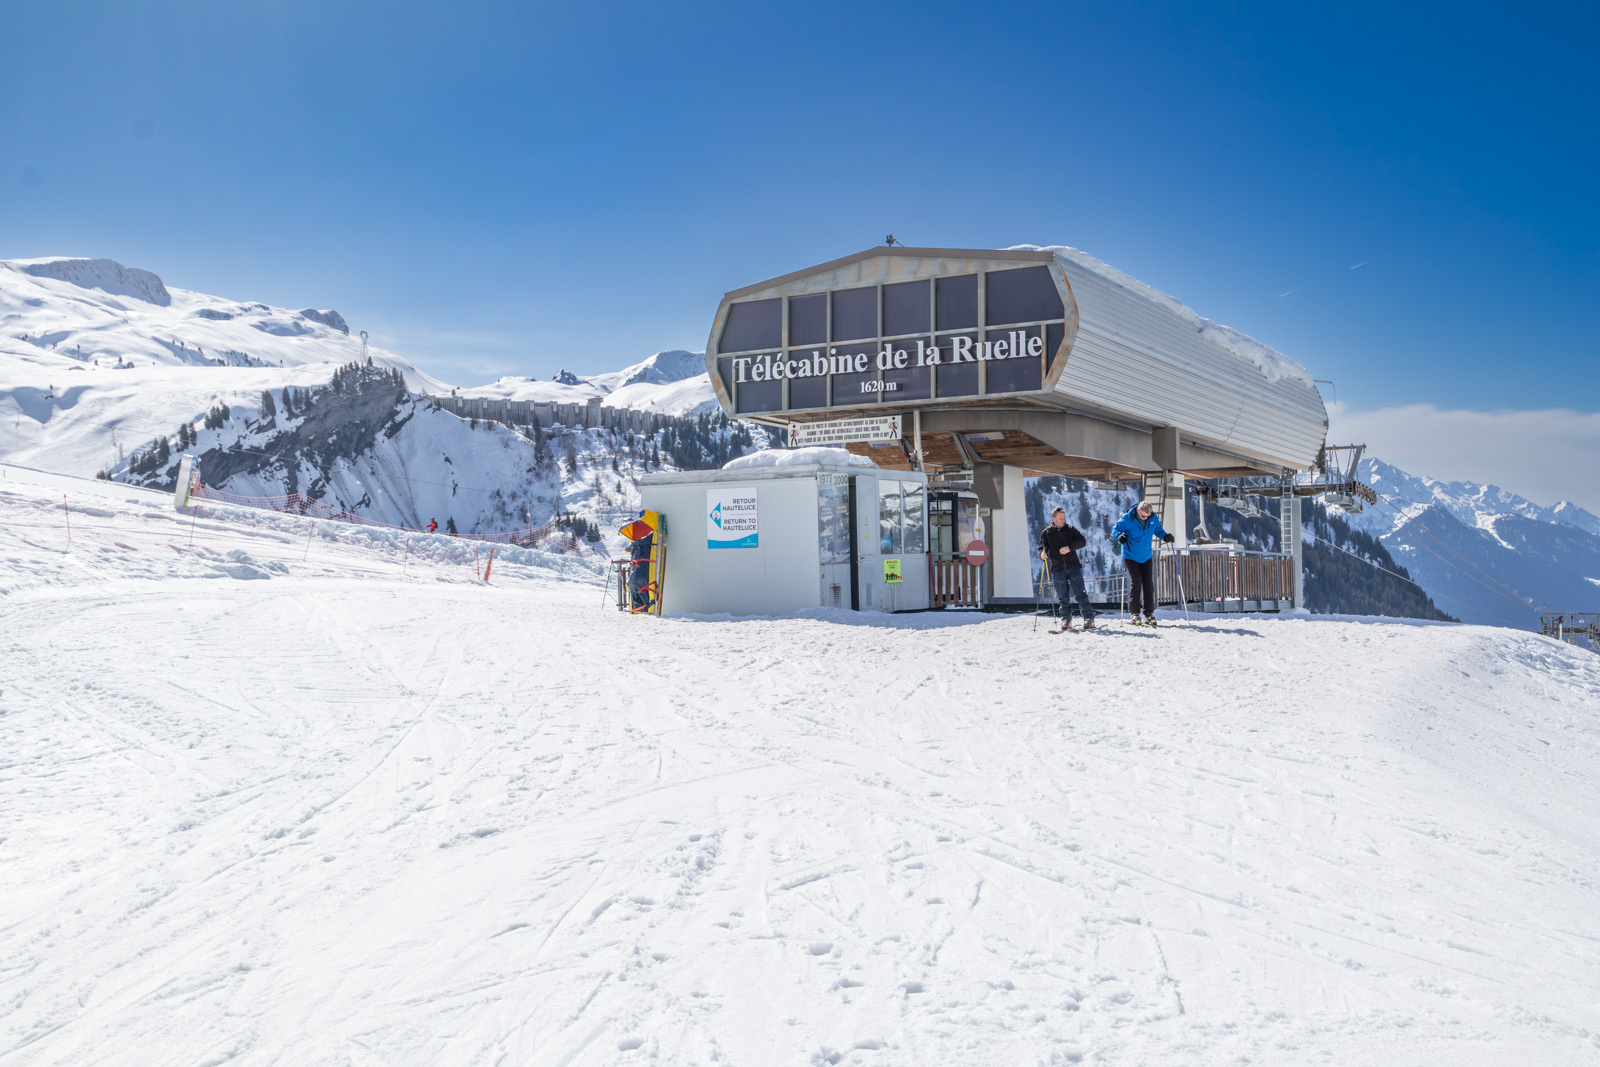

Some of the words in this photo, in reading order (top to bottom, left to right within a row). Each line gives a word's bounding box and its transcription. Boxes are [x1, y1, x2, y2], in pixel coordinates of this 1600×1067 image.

[733, 348, 868, 383] Télécabine
[876, 343, 908, 371] de
[916, 340, 941, 367] la
[950, 330, 1043, 364] Ruelle
[860, 380, 884, 393] 1620
[886, 381, 897, 391] m
